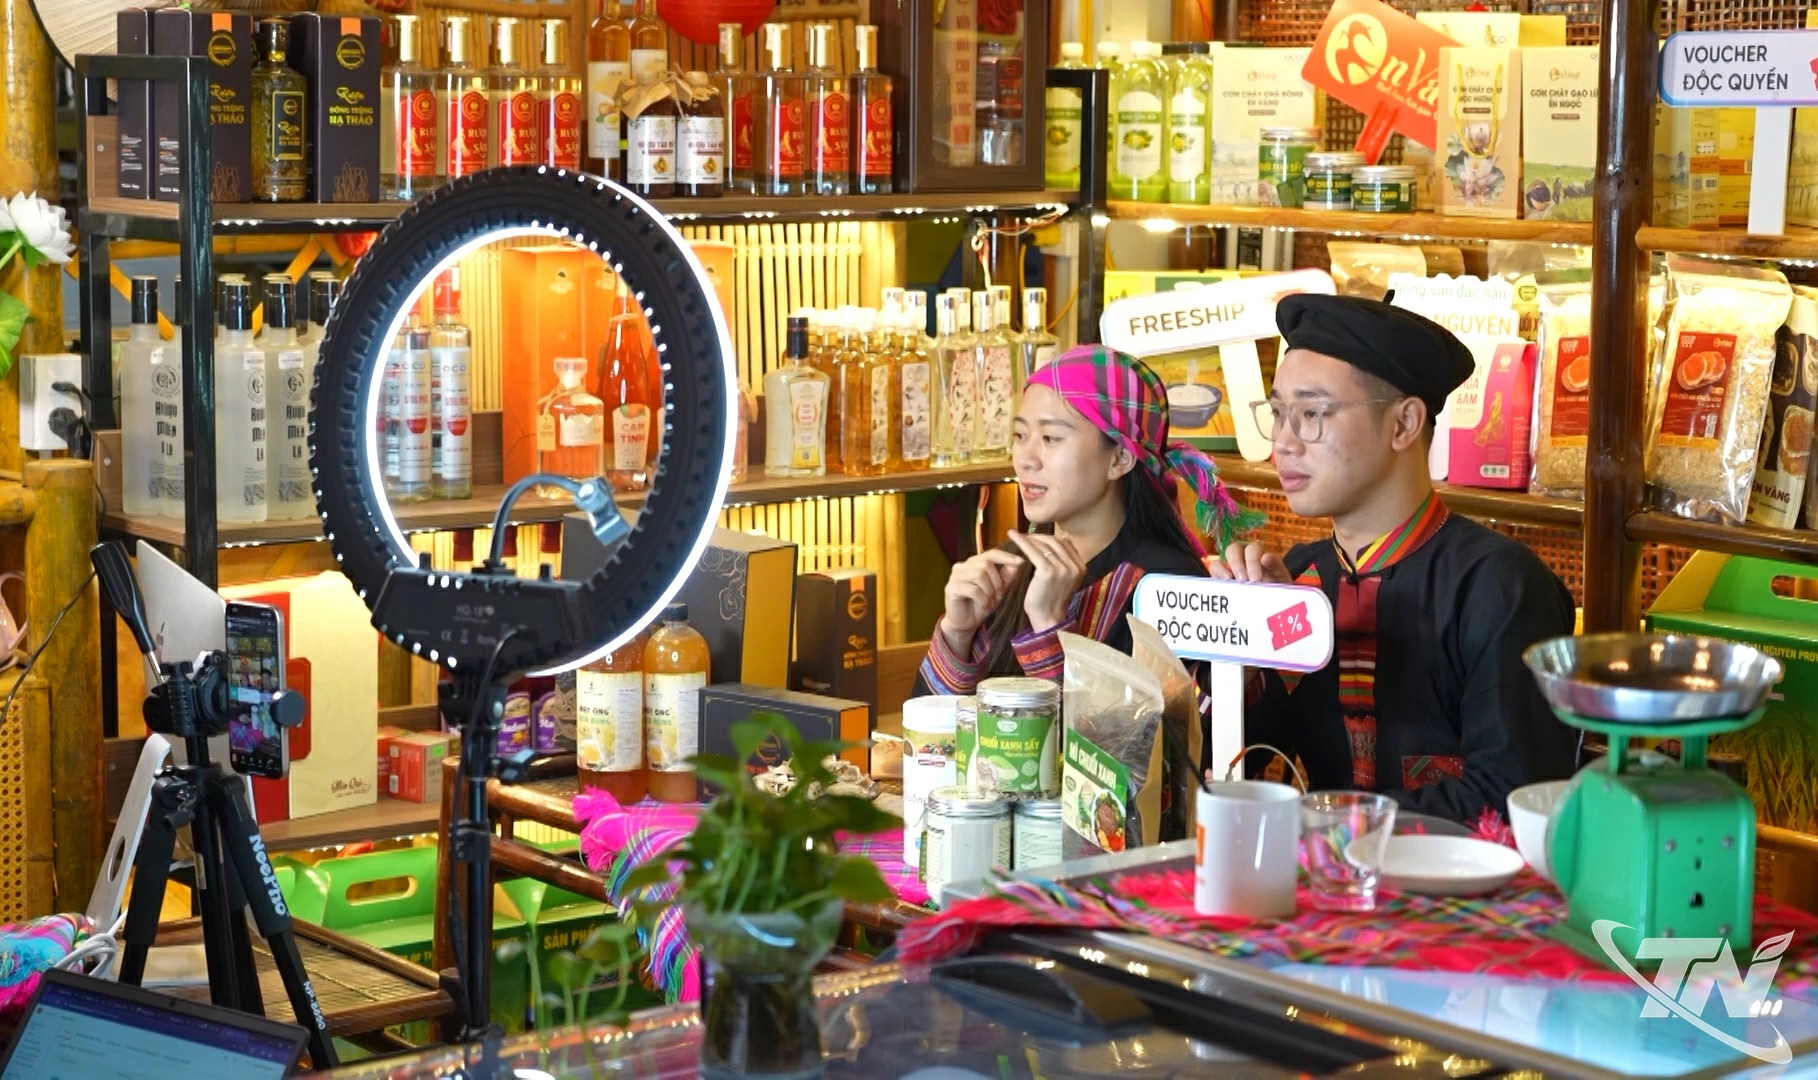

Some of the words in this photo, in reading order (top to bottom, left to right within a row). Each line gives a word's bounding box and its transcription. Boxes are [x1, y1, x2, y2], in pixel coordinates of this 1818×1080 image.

[1683, 45, 1768, 64] VOUCHER
[1682, 69, 1723, 96] ĐỘC
[1129, 303, 1244, 335] FREESHIP
[1156, 590, 1229, 614] VOUCHER
[1158, 616, 1192, 643] ĐỘC
[1763, 645, 1796, 659] NGUYEN
[1798, 650, 1818, 663] PROV
